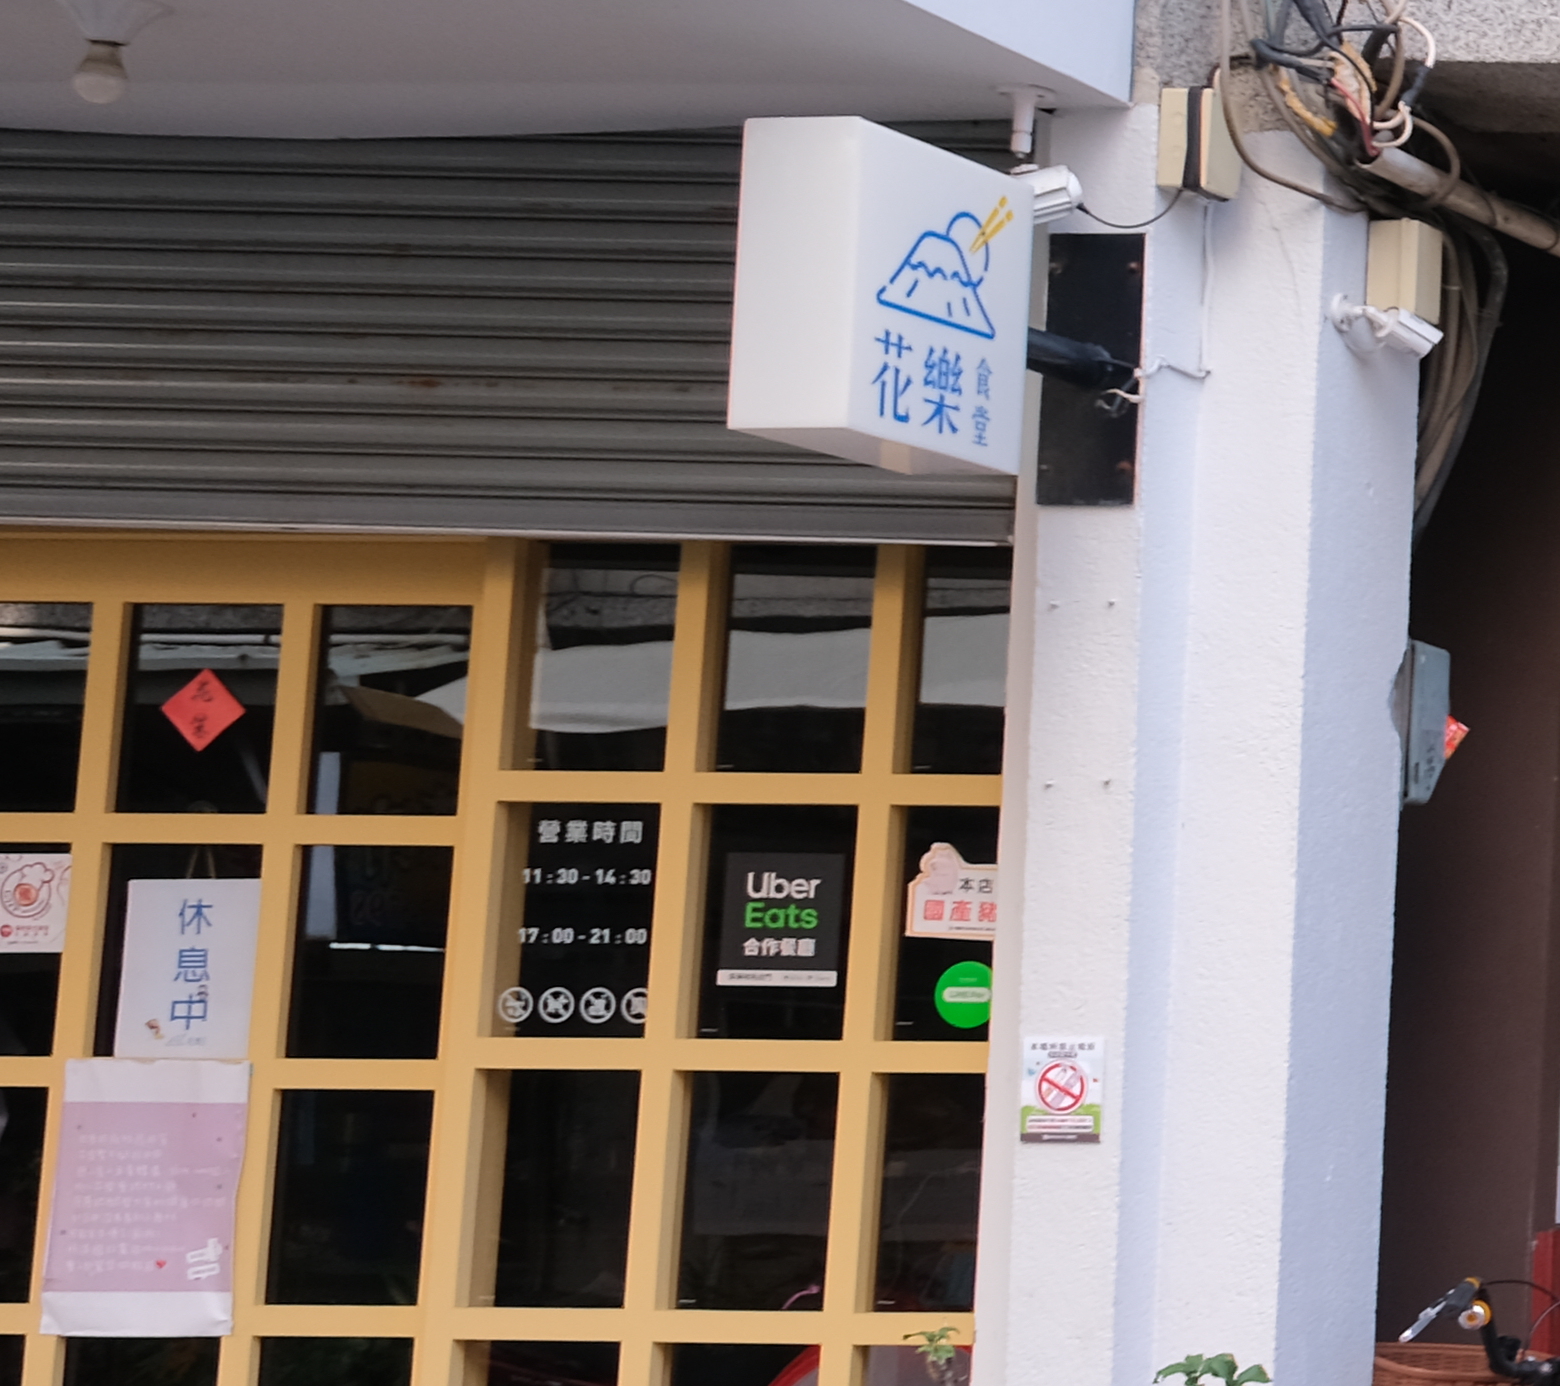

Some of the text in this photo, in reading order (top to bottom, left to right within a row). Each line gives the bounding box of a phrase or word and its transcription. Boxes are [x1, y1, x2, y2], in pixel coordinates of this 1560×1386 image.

[873, 328, 964, 436] 花樂
[970, 357, 993, 448] 食堂
[537, 819, 644, 844] 營業時間
[746, 871, 822, 900] Uber
[958, 877, 994, 894] 本店
[744, 901, 819, 929] Eats
[169, 898, 214, 1031] 休息中
